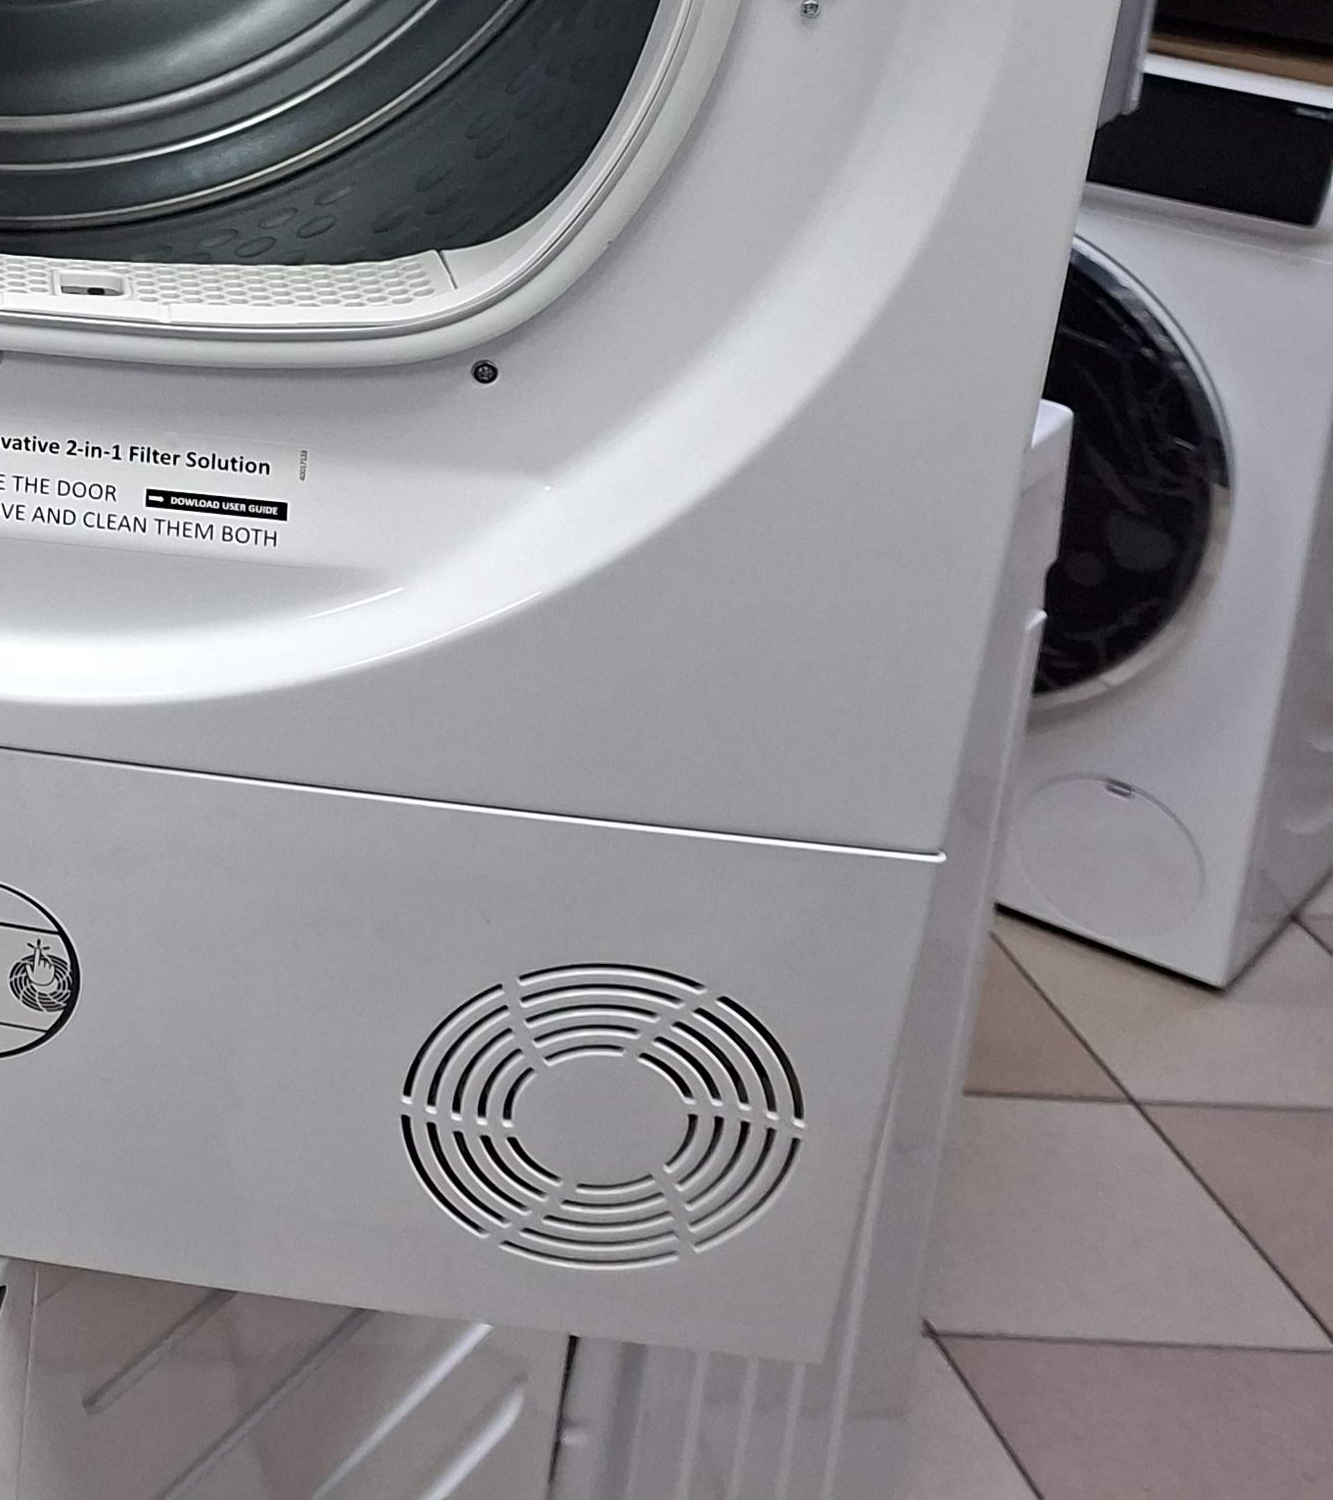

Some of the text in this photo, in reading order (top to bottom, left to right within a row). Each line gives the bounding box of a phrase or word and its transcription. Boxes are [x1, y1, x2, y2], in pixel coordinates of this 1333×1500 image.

[66, 439, 122, 461] 2-in-1
[129, 446, 181, 467] Filter
[185, 451, 271, 476] Solution
[12, 475, 51, 495] THE
[57, 480, 117, 502] DOOR
[170, 496, 279, 516] DOWLOAD USER GUIDE
[31, 506, 77, 526] AND
[83, 511, 147, 534] CLEAN
[153, 518, 214, 541] THEM
[221, 525, 278, 547] BOTH
